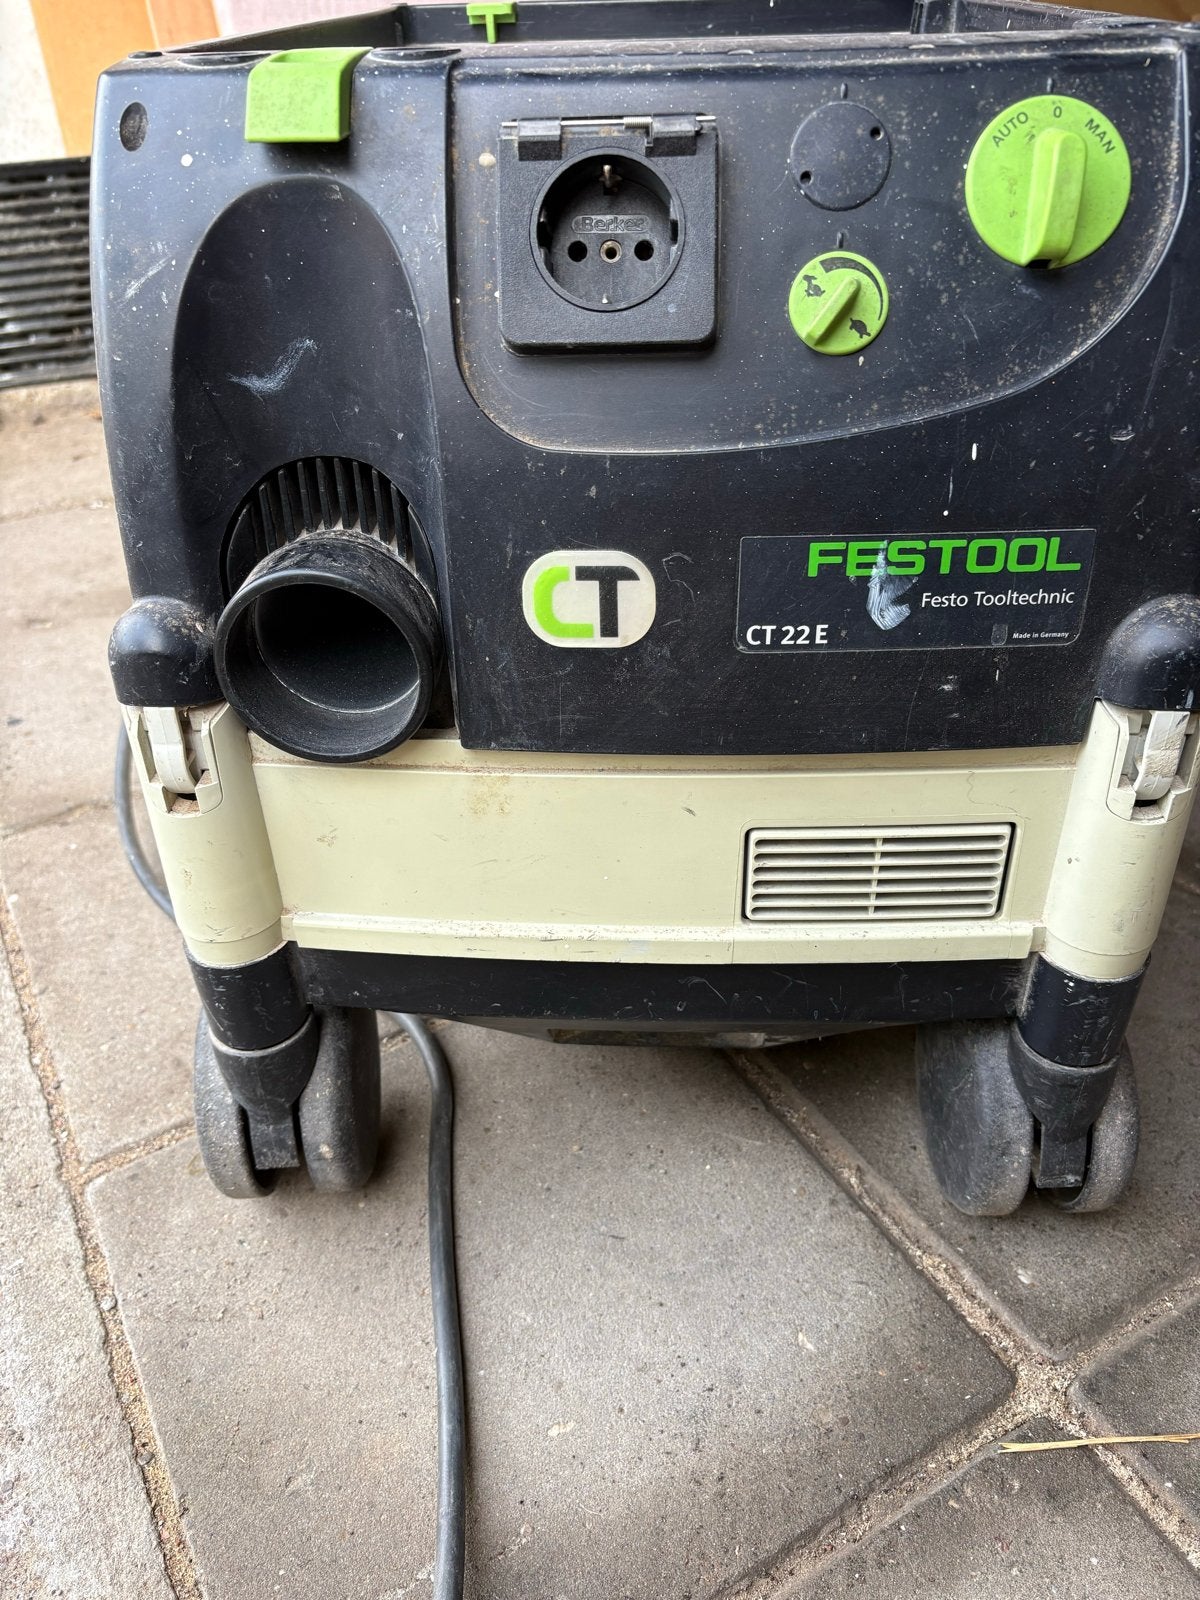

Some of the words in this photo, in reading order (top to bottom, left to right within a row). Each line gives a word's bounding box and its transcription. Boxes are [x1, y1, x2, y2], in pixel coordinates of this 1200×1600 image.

[991, 111, 1029, 148] AUTO
[1084, 118, 1116, 155] MAN
[807, 537, 1082, 578] FESTOOL
[533, 565, 641, 638] CT
[921, 592, 969, 608] Festo
[974, 588, 1075, 606] Tooltechnic
[746, 625, 777, 645] CT
[780, 625, 811, 645] 22
[815, 624, 829, 645] E
[1040, 631, 1070, 639] Germany
